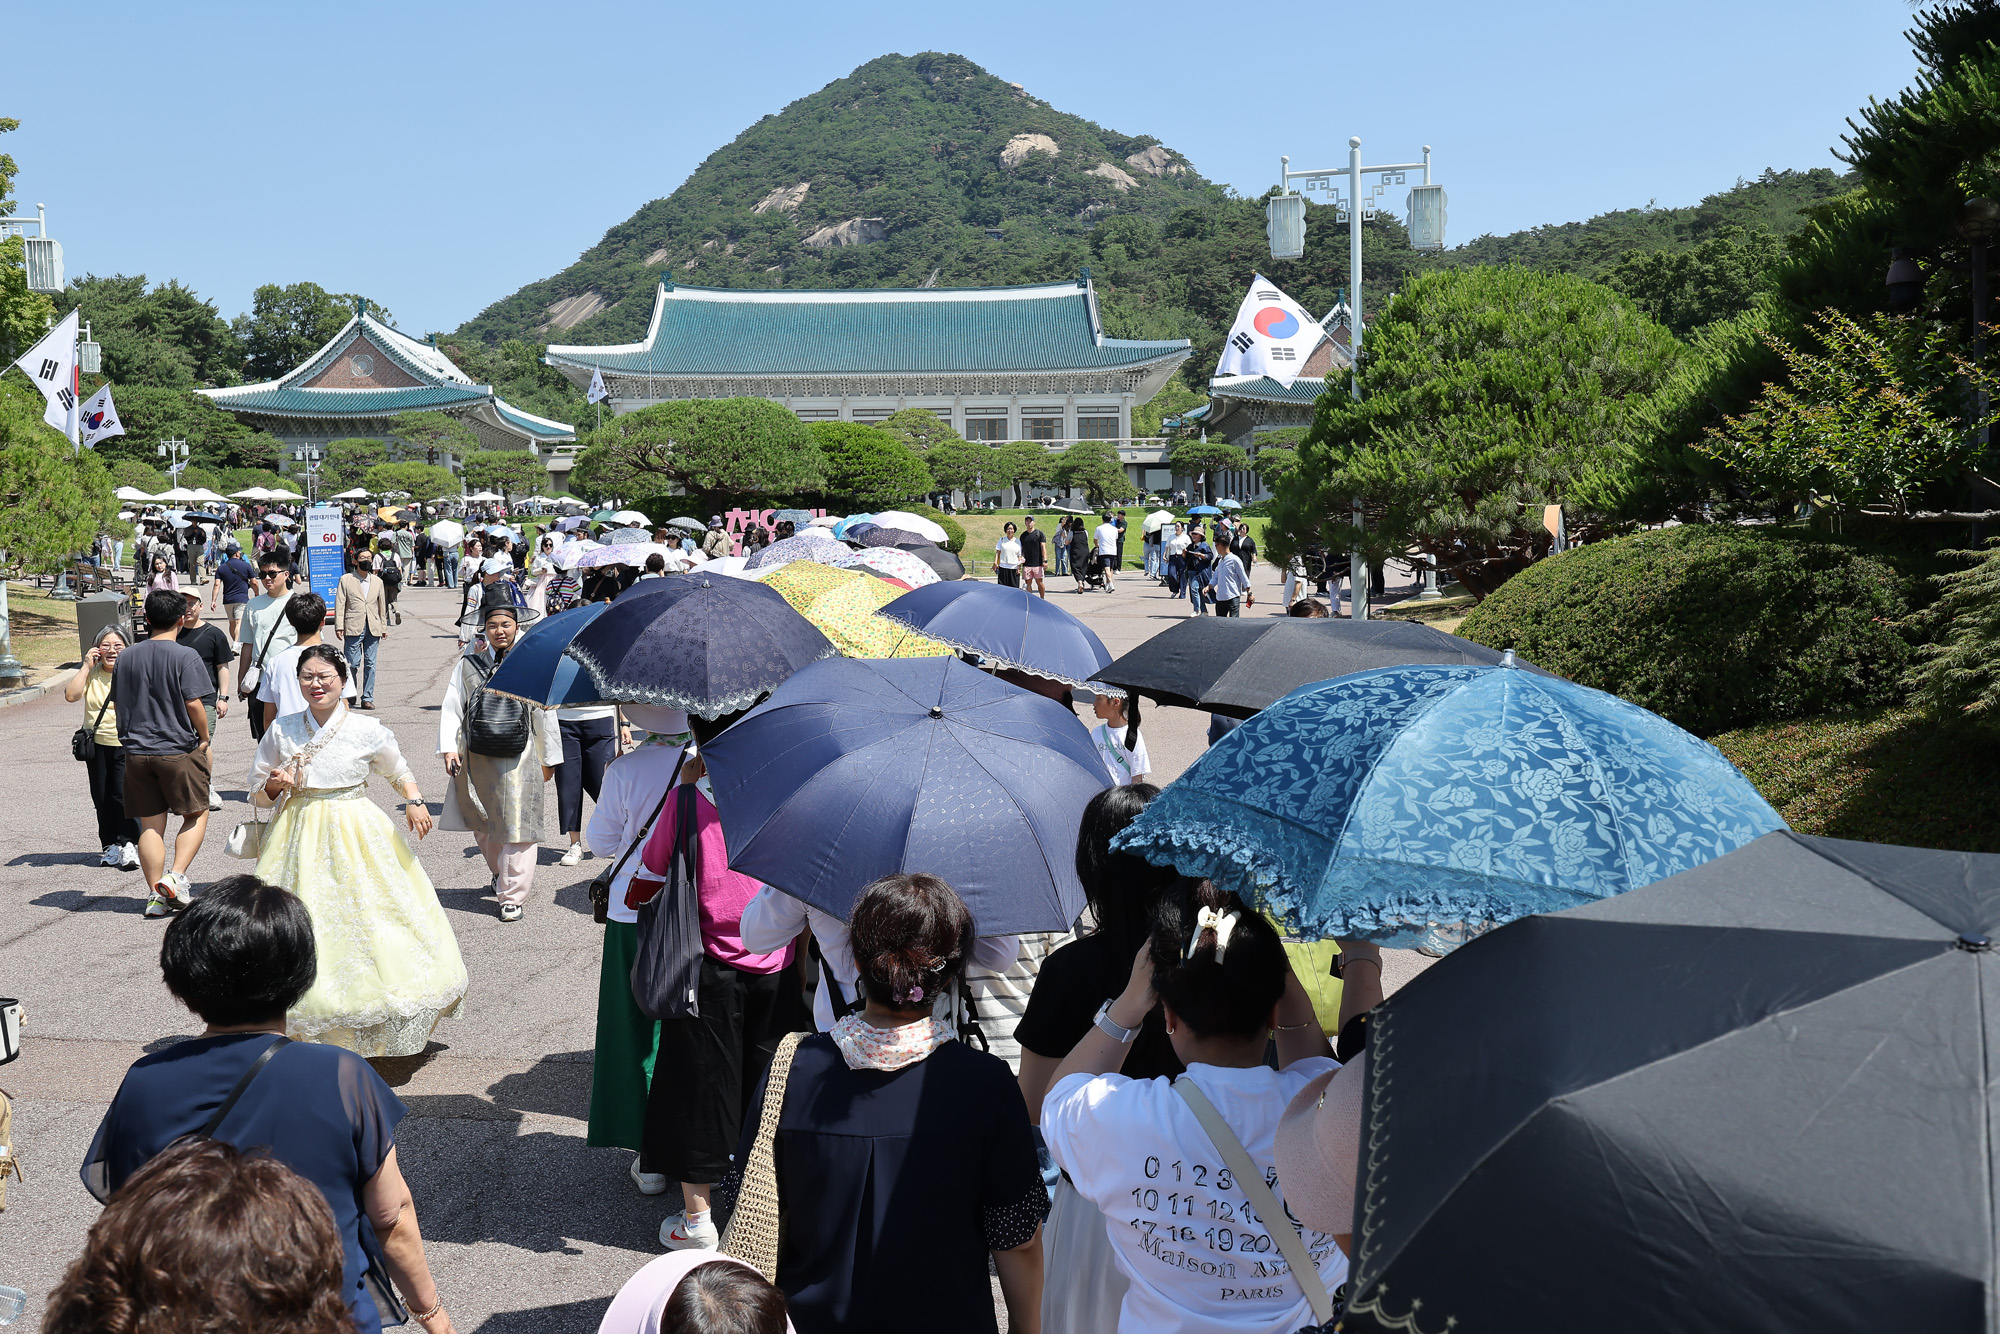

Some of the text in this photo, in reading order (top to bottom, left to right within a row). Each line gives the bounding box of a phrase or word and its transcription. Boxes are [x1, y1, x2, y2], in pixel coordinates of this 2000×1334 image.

[323, 533, 336, 542] 60
[1144, 1155, 1160, 1179] 0
[1171, 1160, 1182, 1182] 1
[1192, 1164, 1208, 1187] 2
[1216, 1168, 1233, 1190] 3
[1131, 1187, 1159, 1212] 10
[1168, 1192, 1195, 1216] 11
[1207, 1199, 1236, 1223] 12
[1130, 1218, 1158, 1235] 17
[1204, 1227, 1234, 1252] 19
[1239, 1233, 1271, 1253] 20
[1137, 1232, 1237, 1279] Maison
[1219, 1284, 1284, 1301] PARIS
